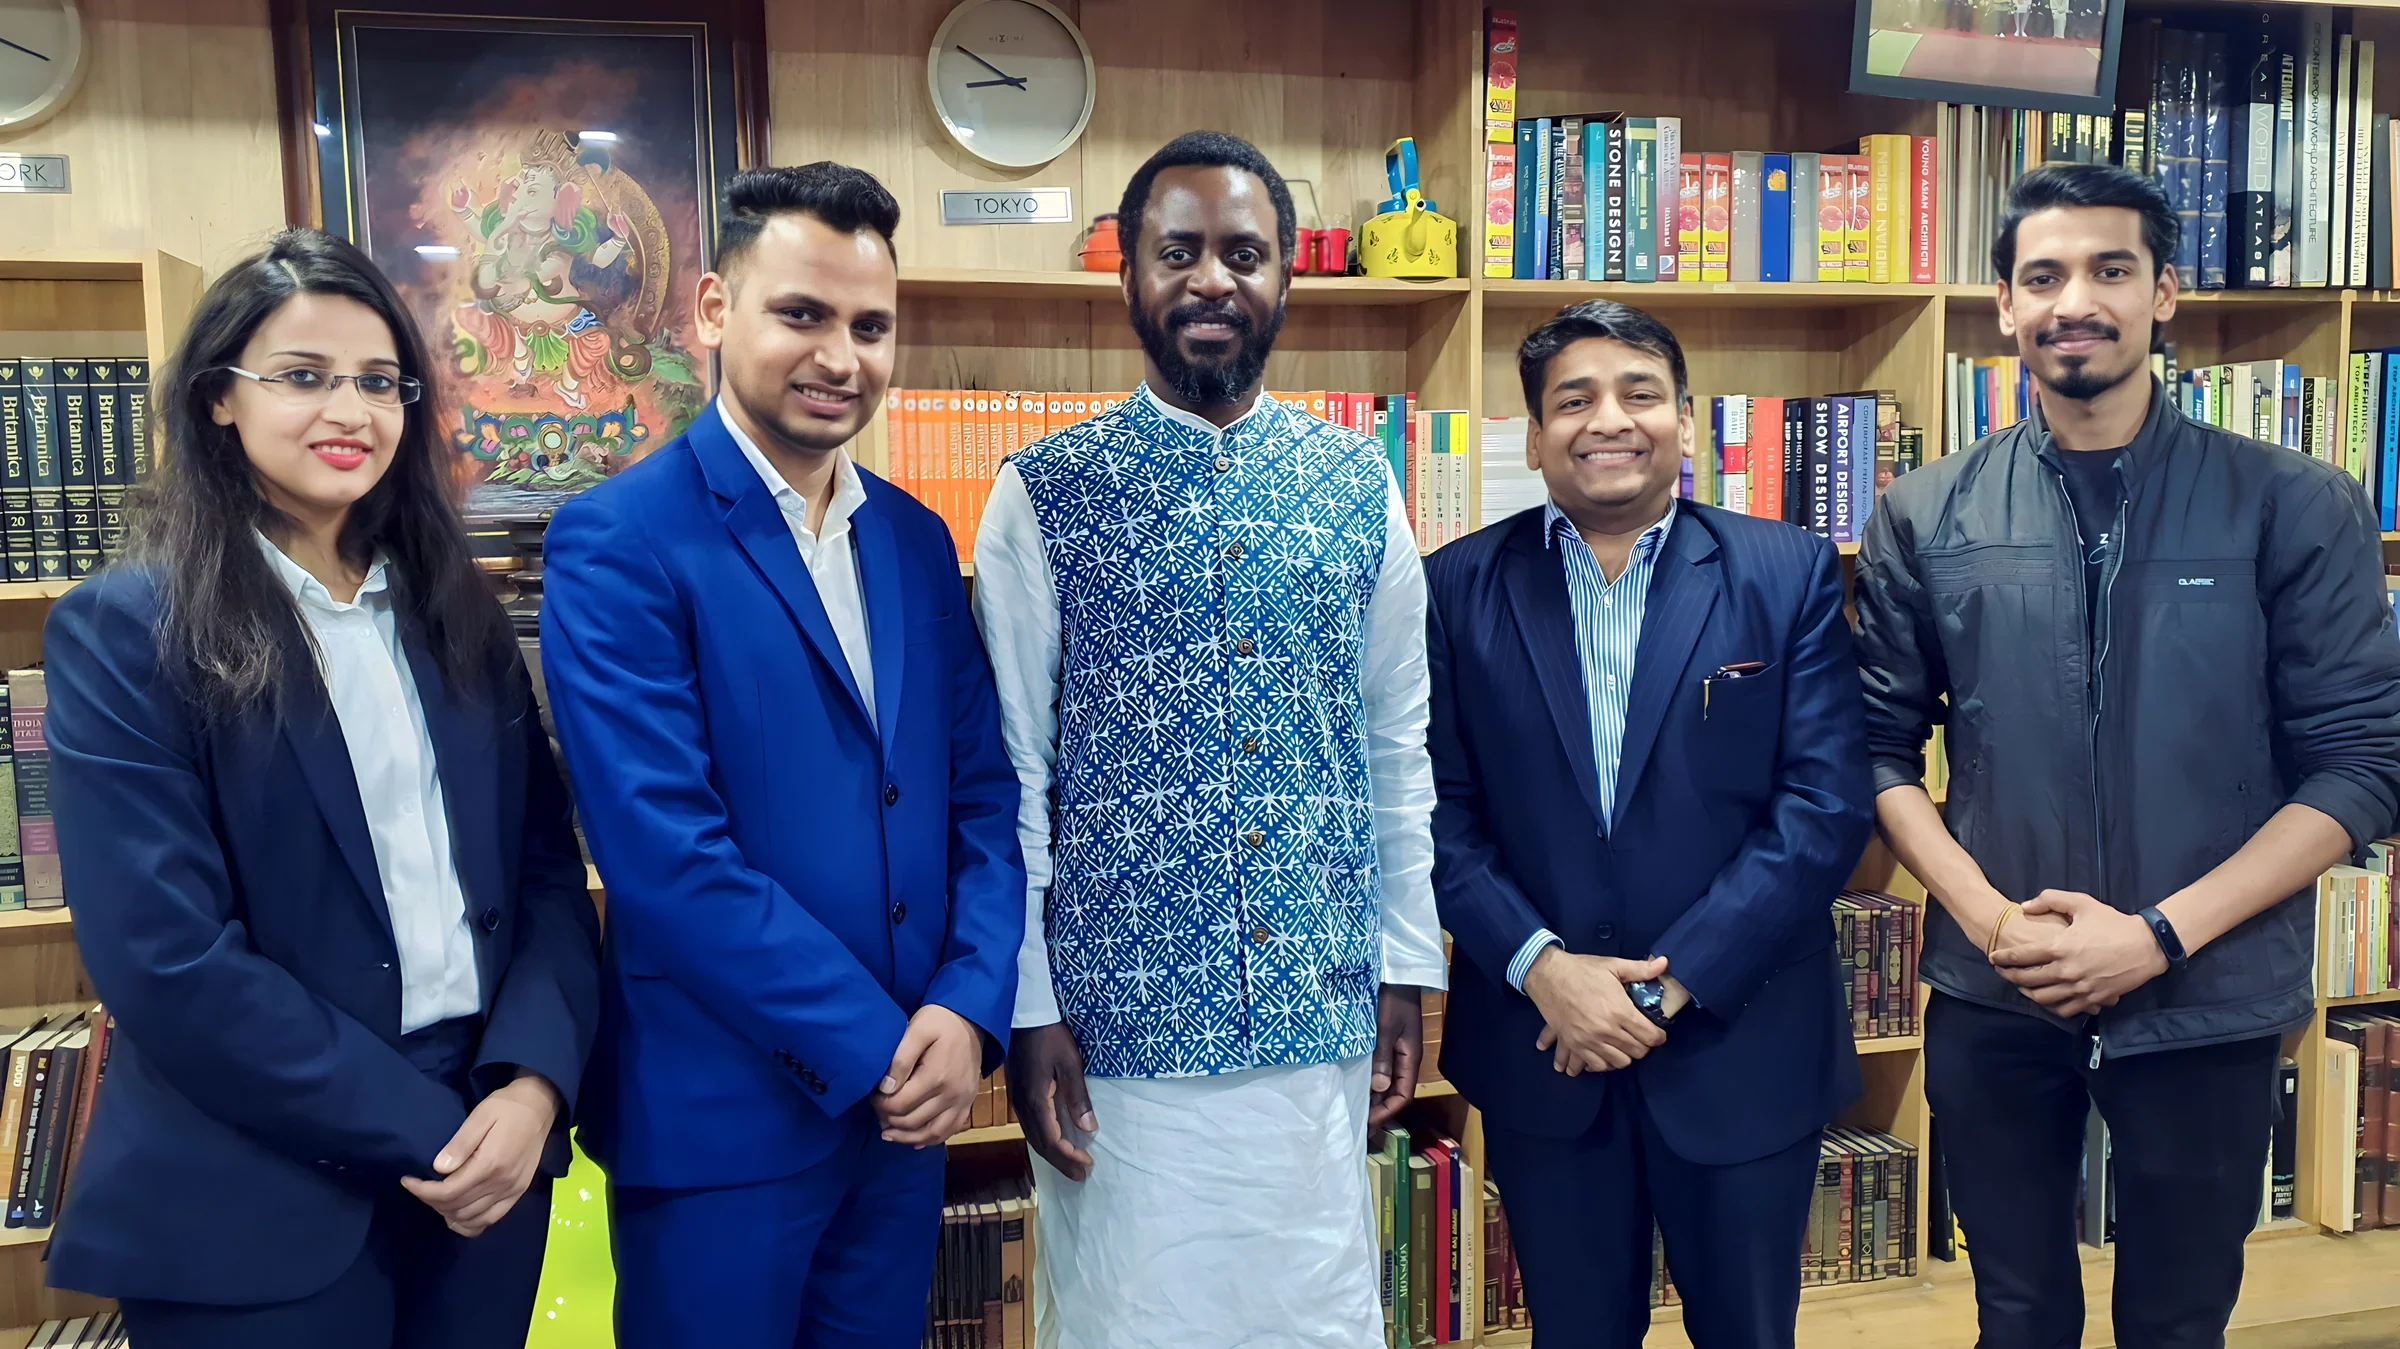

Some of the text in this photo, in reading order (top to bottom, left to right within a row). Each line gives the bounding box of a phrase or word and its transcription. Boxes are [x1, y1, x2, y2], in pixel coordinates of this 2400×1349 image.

[2307, 38, 2321, 126] CONTEMPORARY
[1608, 129, 1622, 263] STONE DESIGN
[1921, 139, 1930, 175] YOUNG
[1921, 179, 1929, 209] ASIAN
[974, 197, 1038, 214] TOKYO
[1875, 150, 1889, 280] INDIAN DESIGN
[2308, 166, 2318, 244] ARCHITECTURE
[2, 396, 22, 478] Britannica
[34, 396, 52, 478] Britannica
[67, 394, 87, 477] Britannica
[98, 394, 117, 477] Britannica
[130, 393, 147, 475] Britannica
[2305, 382, 2313, 410] NEW
[2389, 385, 2397, 443] ARCHITECTS
[1815, 402, 1828, 527] SHOW DESIGN
[1836, 403, 1849, 526] AIRPORT DESIGN
[10, 516, 25, 527] 20
[41, 515, 54, 526] 21
[75, 513, 89, 525] 22
